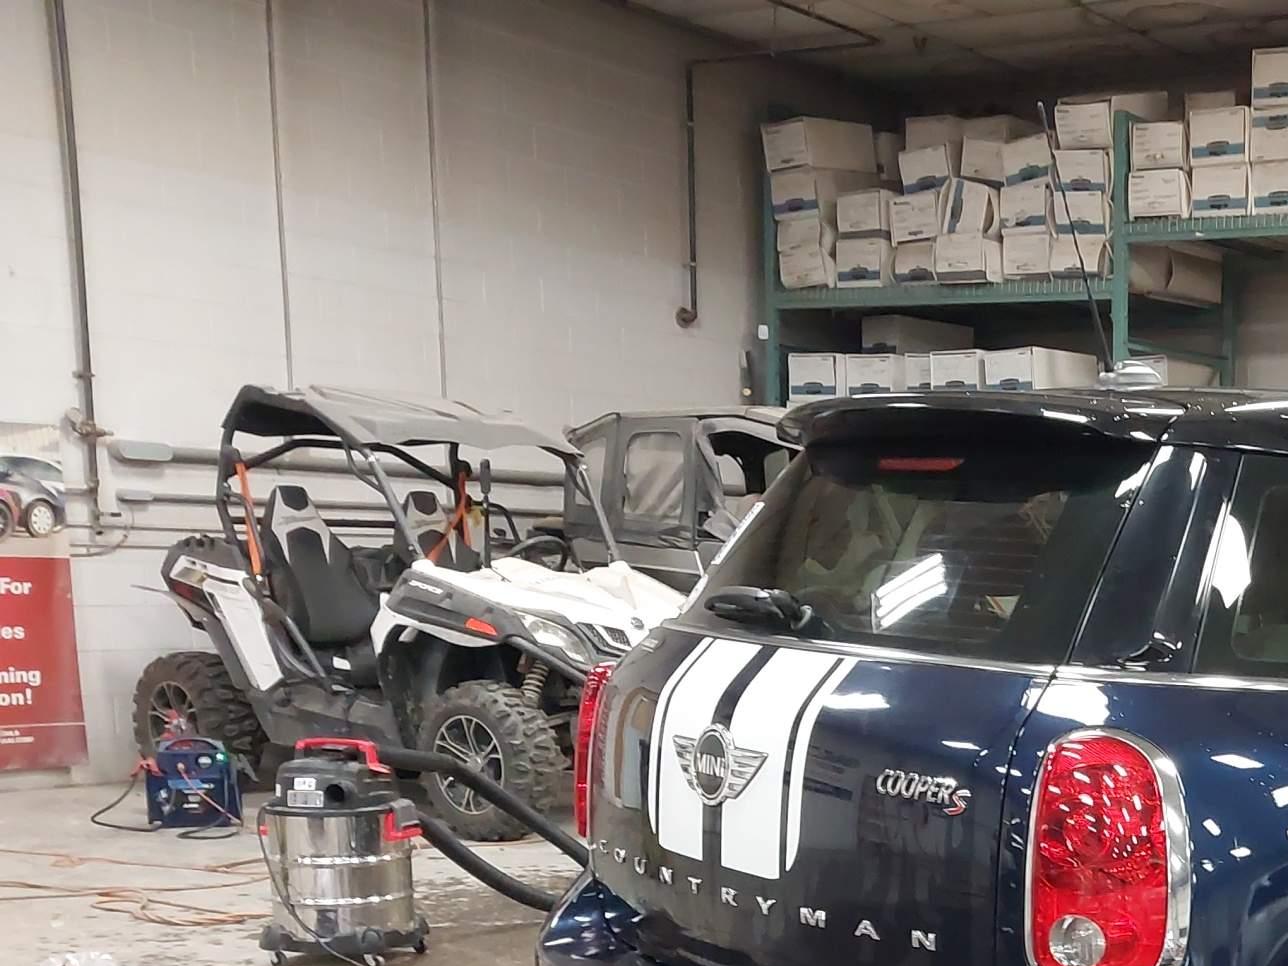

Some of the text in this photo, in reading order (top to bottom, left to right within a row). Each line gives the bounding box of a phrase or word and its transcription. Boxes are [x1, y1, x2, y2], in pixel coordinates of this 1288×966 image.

[0, 577, 32, 595] For
[696, 751, 725, 777] MINI
[599, 839, 937, 952] COUNTRYMAN
